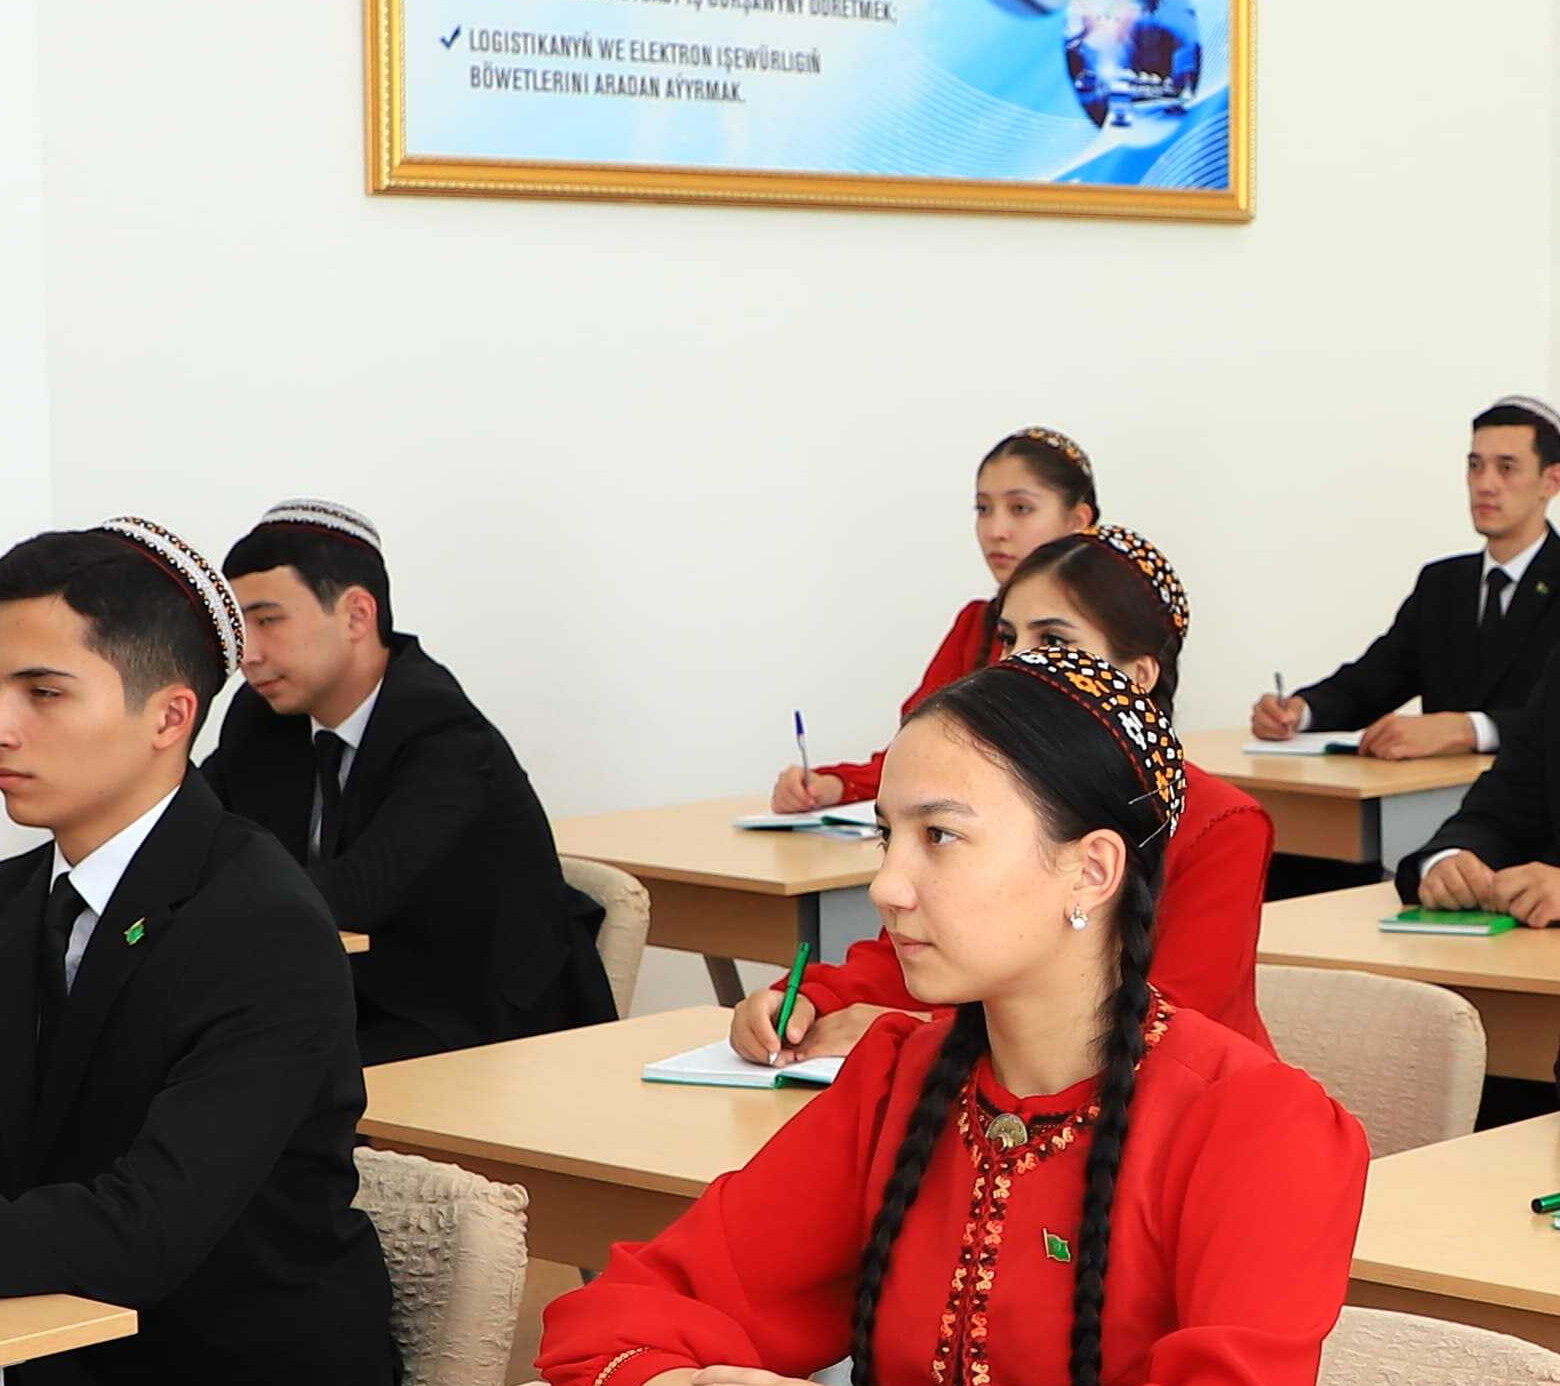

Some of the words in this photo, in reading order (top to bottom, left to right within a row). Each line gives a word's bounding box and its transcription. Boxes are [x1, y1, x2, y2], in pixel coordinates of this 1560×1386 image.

[469, 27, 593, 58] LOGISTIKANYŇ
[598, 38, 625, 62] WE
[630, 40, 712, 67] ELEKTRON
[470, 61, 589, 95] BÖWETLERINI
[594, 73, 661, 99] ARADAN
